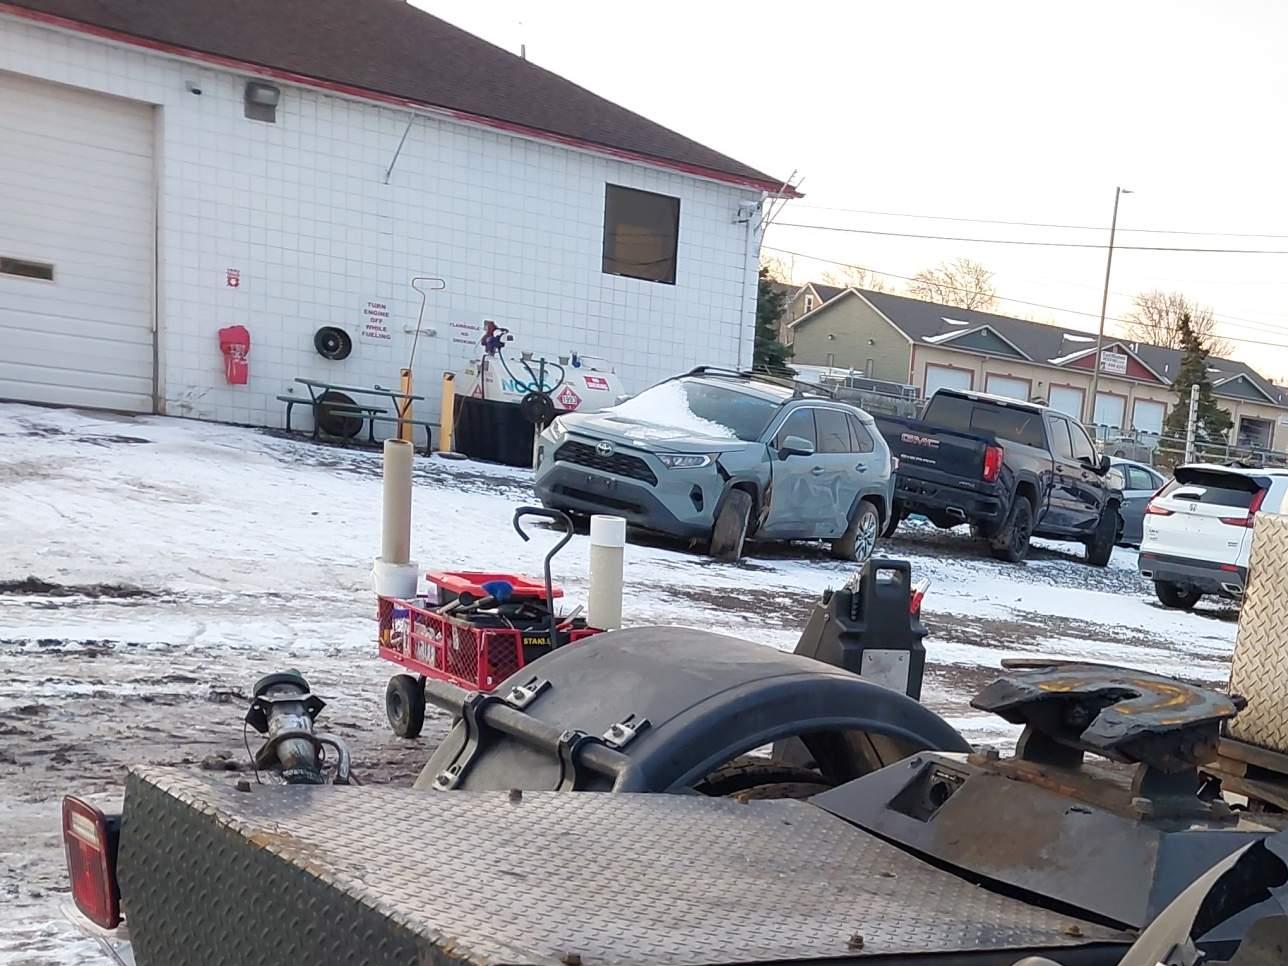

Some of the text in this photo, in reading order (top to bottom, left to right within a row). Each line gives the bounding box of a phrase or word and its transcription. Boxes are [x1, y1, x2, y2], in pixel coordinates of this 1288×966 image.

[367, 301, 387, 310] TURN
[364, 309, 389, 317] ENGINE
[365, 324, 388, 332] WHILE
[361, 331, 392, 340] FUELING
[901, 433, 940, 448] GMC
